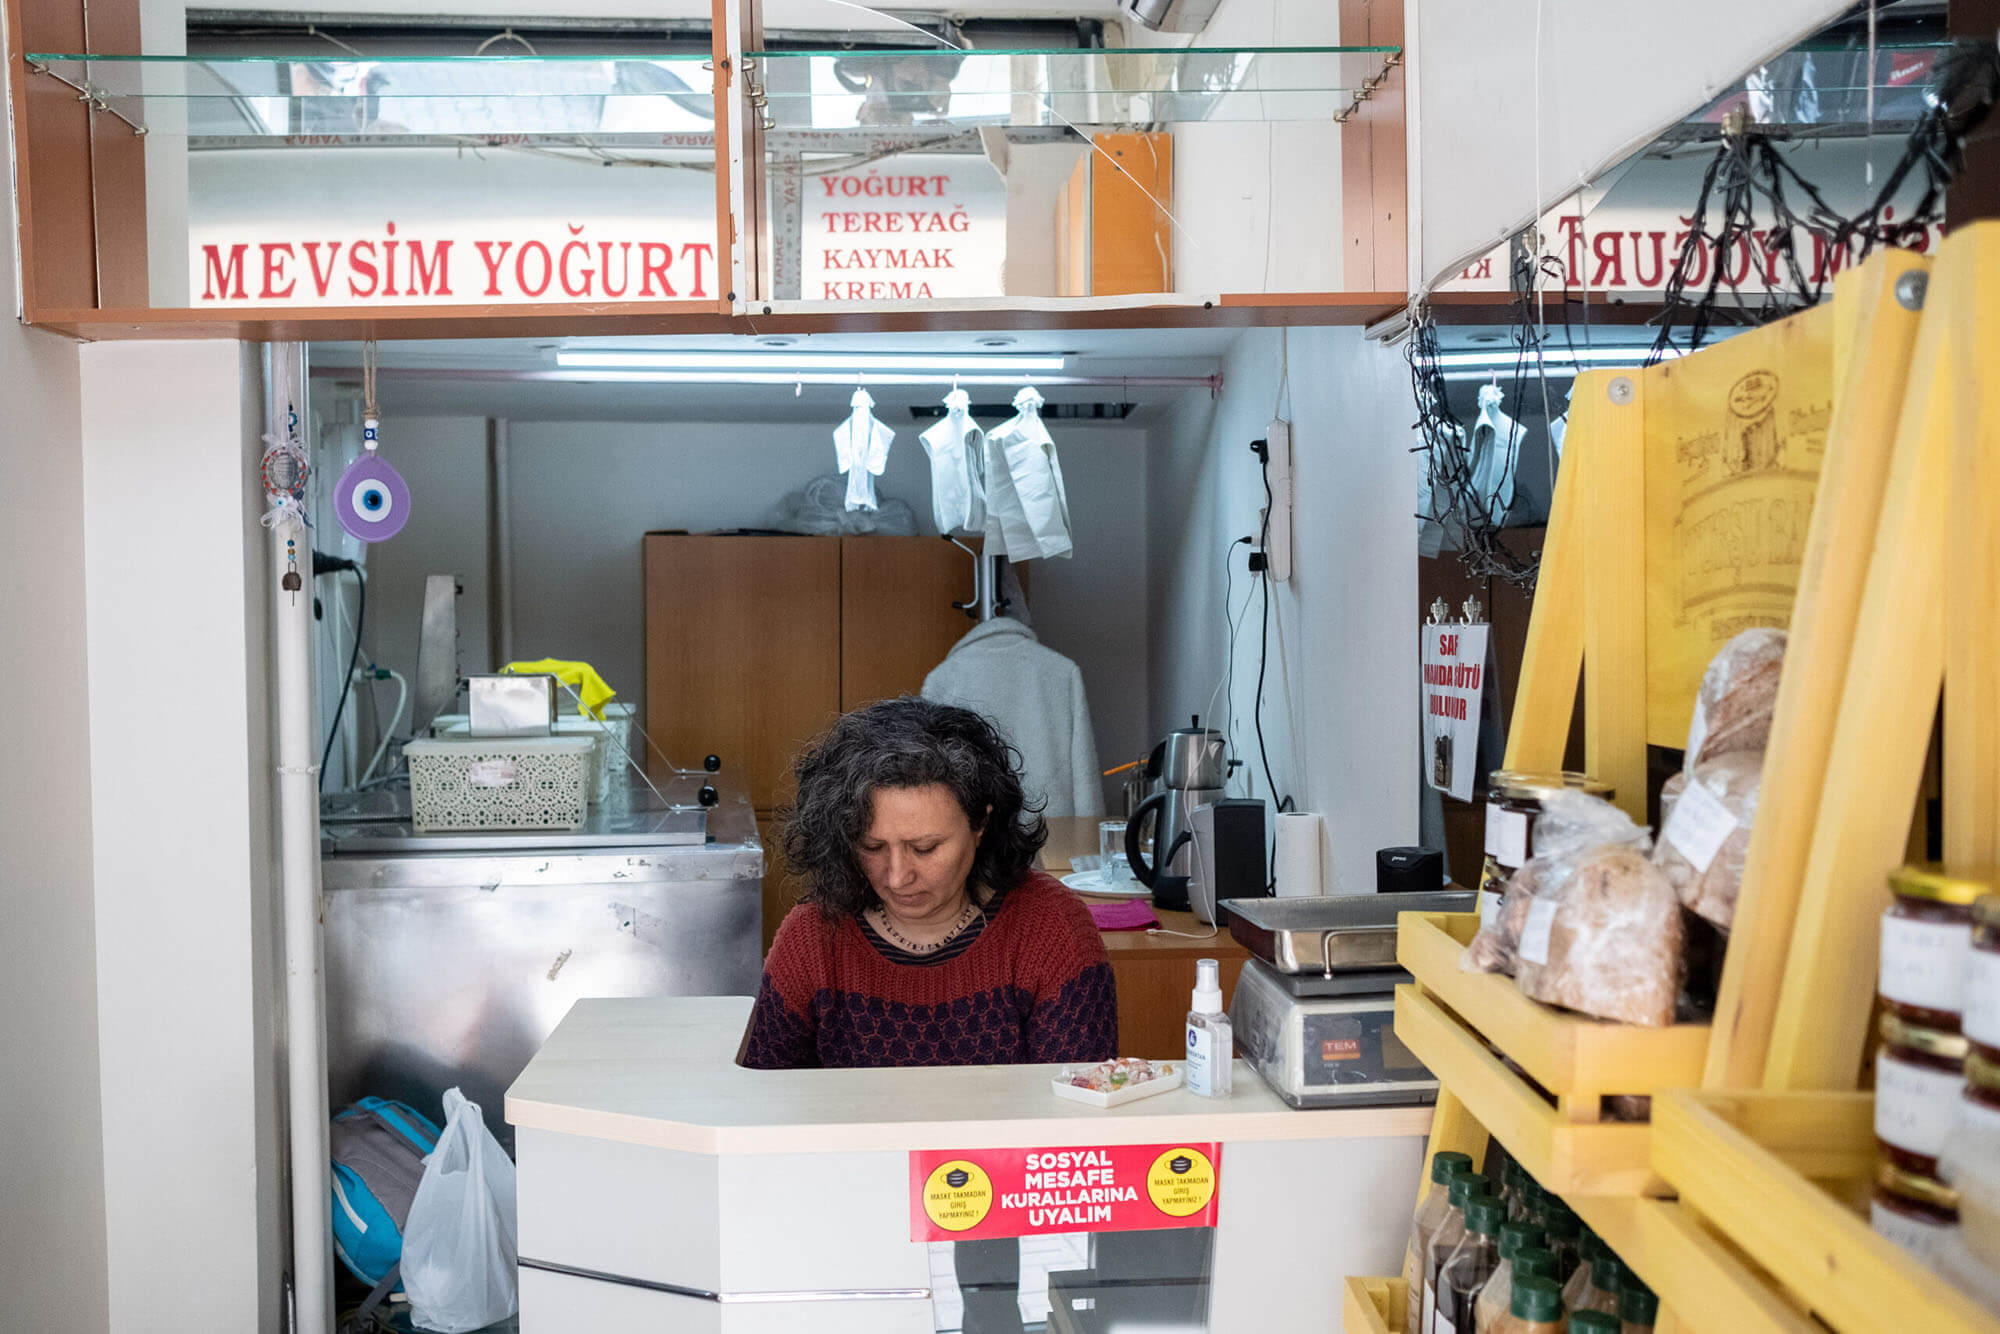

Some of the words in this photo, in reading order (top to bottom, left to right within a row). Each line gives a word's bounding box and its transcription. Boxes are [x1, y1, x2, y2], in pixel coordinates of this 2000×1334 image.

[820, 169, 950, 198] YOĞURT
[822, 204, 969, 233] TEREYAĞ
[202, 221, 454, 300] MEVSİM
[474, 223, 713, 299] YOĞURT
[823, 248, 954, 270] KAYMAK
[823, 281, 933, 300] KREMA
[1325, 1041, 1357, 1051] TEM
[1025, 1150, 1113, 1171] SOSYAL
[1025, 1168, 1114, 1190] MESAFE
[931, 1192, 951, 1200] MASKE
[1001, 1186, 1138, 1209] KURALLARINA
[1028, 1204, 1112, 1227] UYALIM
